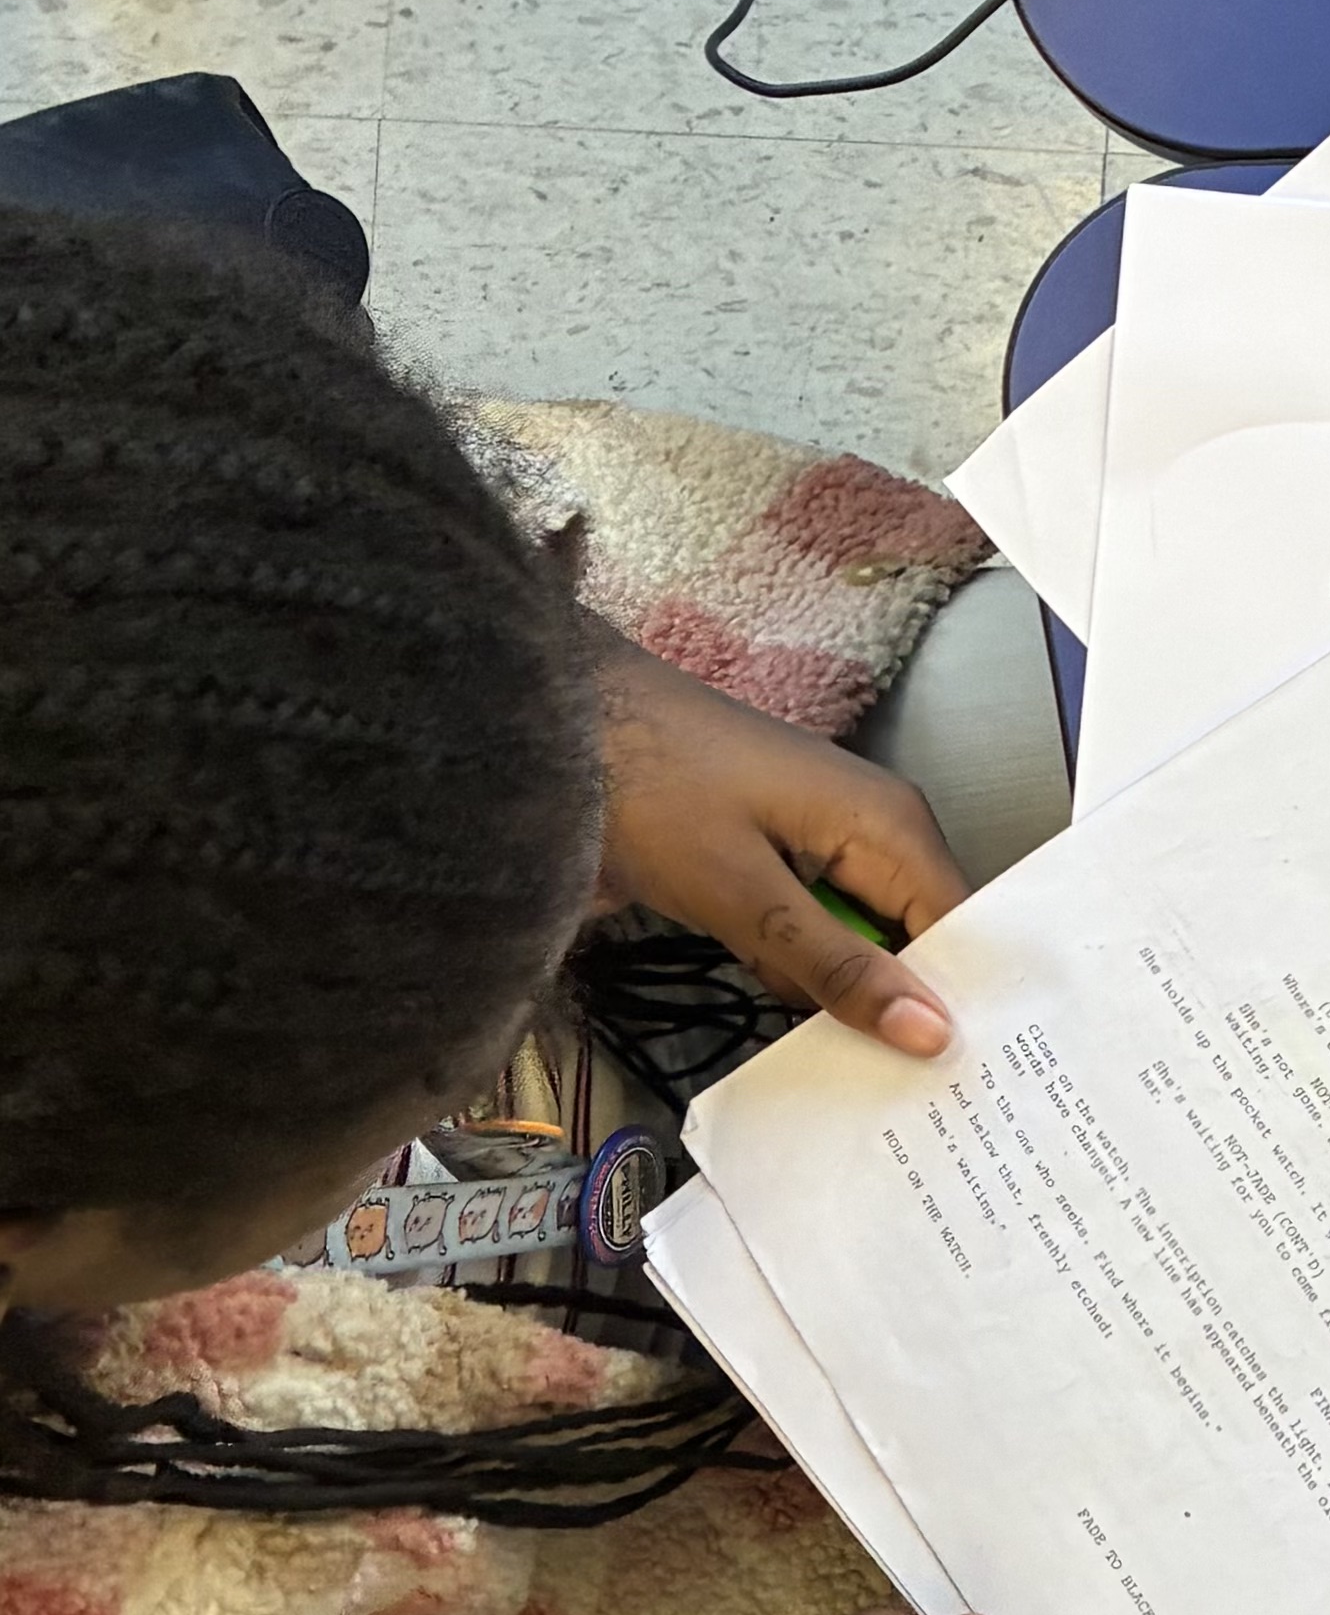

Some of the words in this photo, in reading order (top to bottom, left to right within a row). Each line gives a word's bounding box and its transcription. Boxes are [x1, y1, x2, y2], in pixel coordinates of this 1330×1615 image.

[1138, 947, 1160, 974] She
[1161, 978, 1194, 1023] holds
[1194, 1030, 1210, 1048] up
[1212, 1054, 1232, 1081] the
[1229, 1087, 1271, 1139] pocket
[1272, 1144, 1305, 1195] watch.
[1310, 1201, 1327, 1221] It
[1076, 1507, 1106, 1545] FADE
[1104, 1549, 1122, 1569] TO
